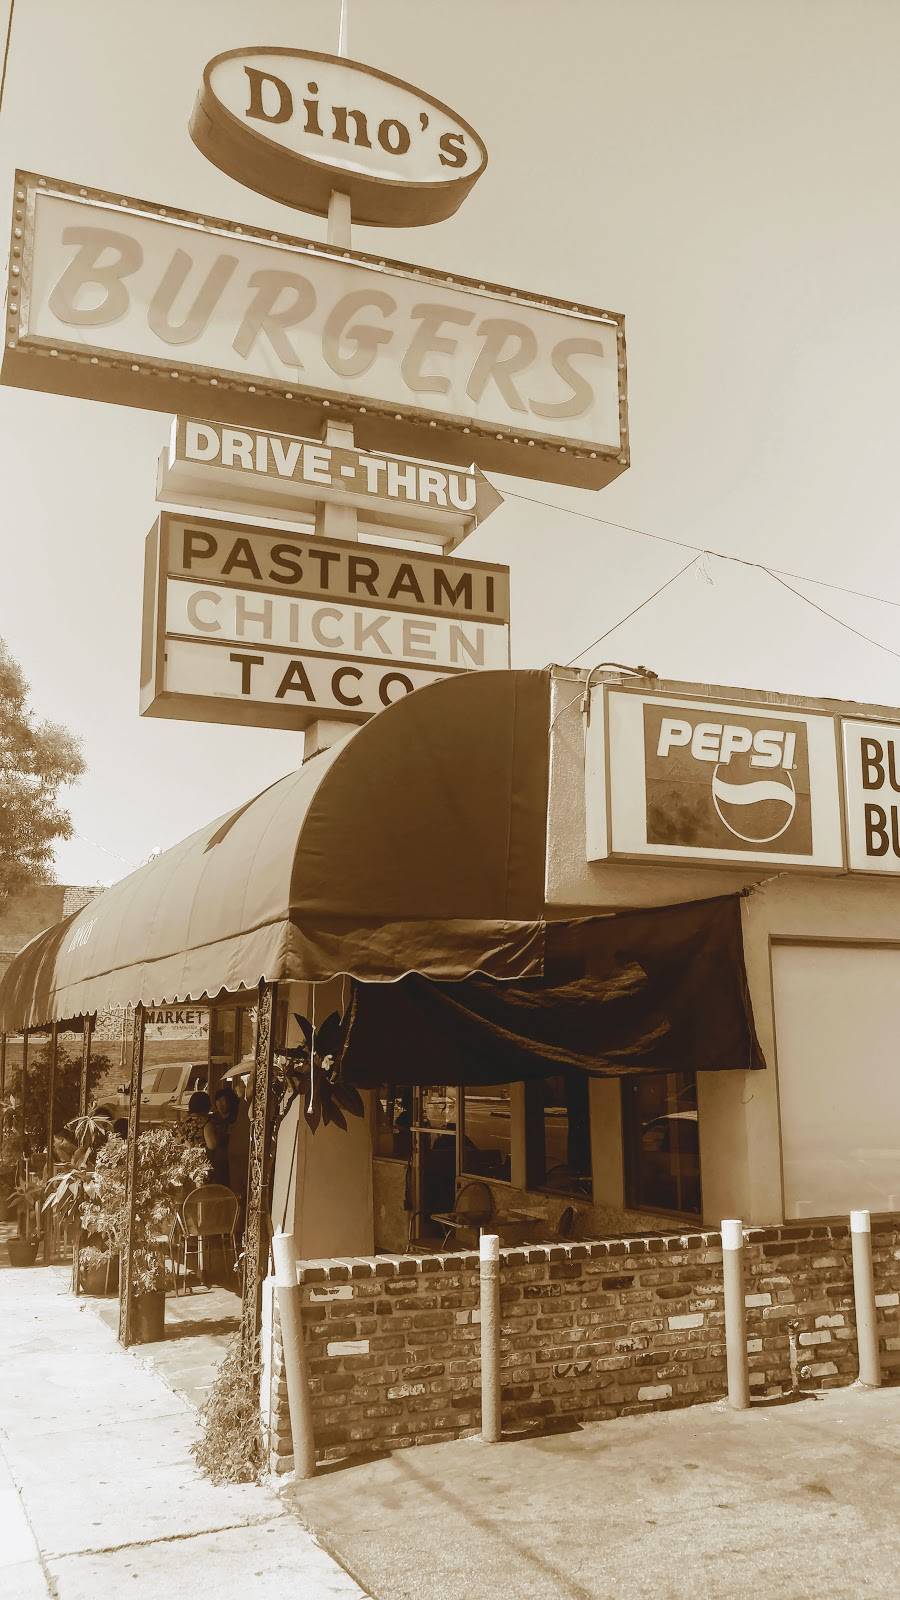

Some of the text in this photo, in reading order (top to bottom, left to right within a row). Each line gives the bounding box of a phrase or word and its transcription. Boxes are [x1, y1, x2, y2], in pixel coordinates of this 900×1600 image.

[244, 65, 469, 169] Dino's
[48, 226, 605, 419] BURGERS
[182, 529, 495, 613] PASTRAMI
[186, 590, 485, 666] CHICKEN
[229, 652, 443, 708] TACO
[656, 717, 797, 770] PEPSI
[144, 1010, 205, 1024] MARKET
